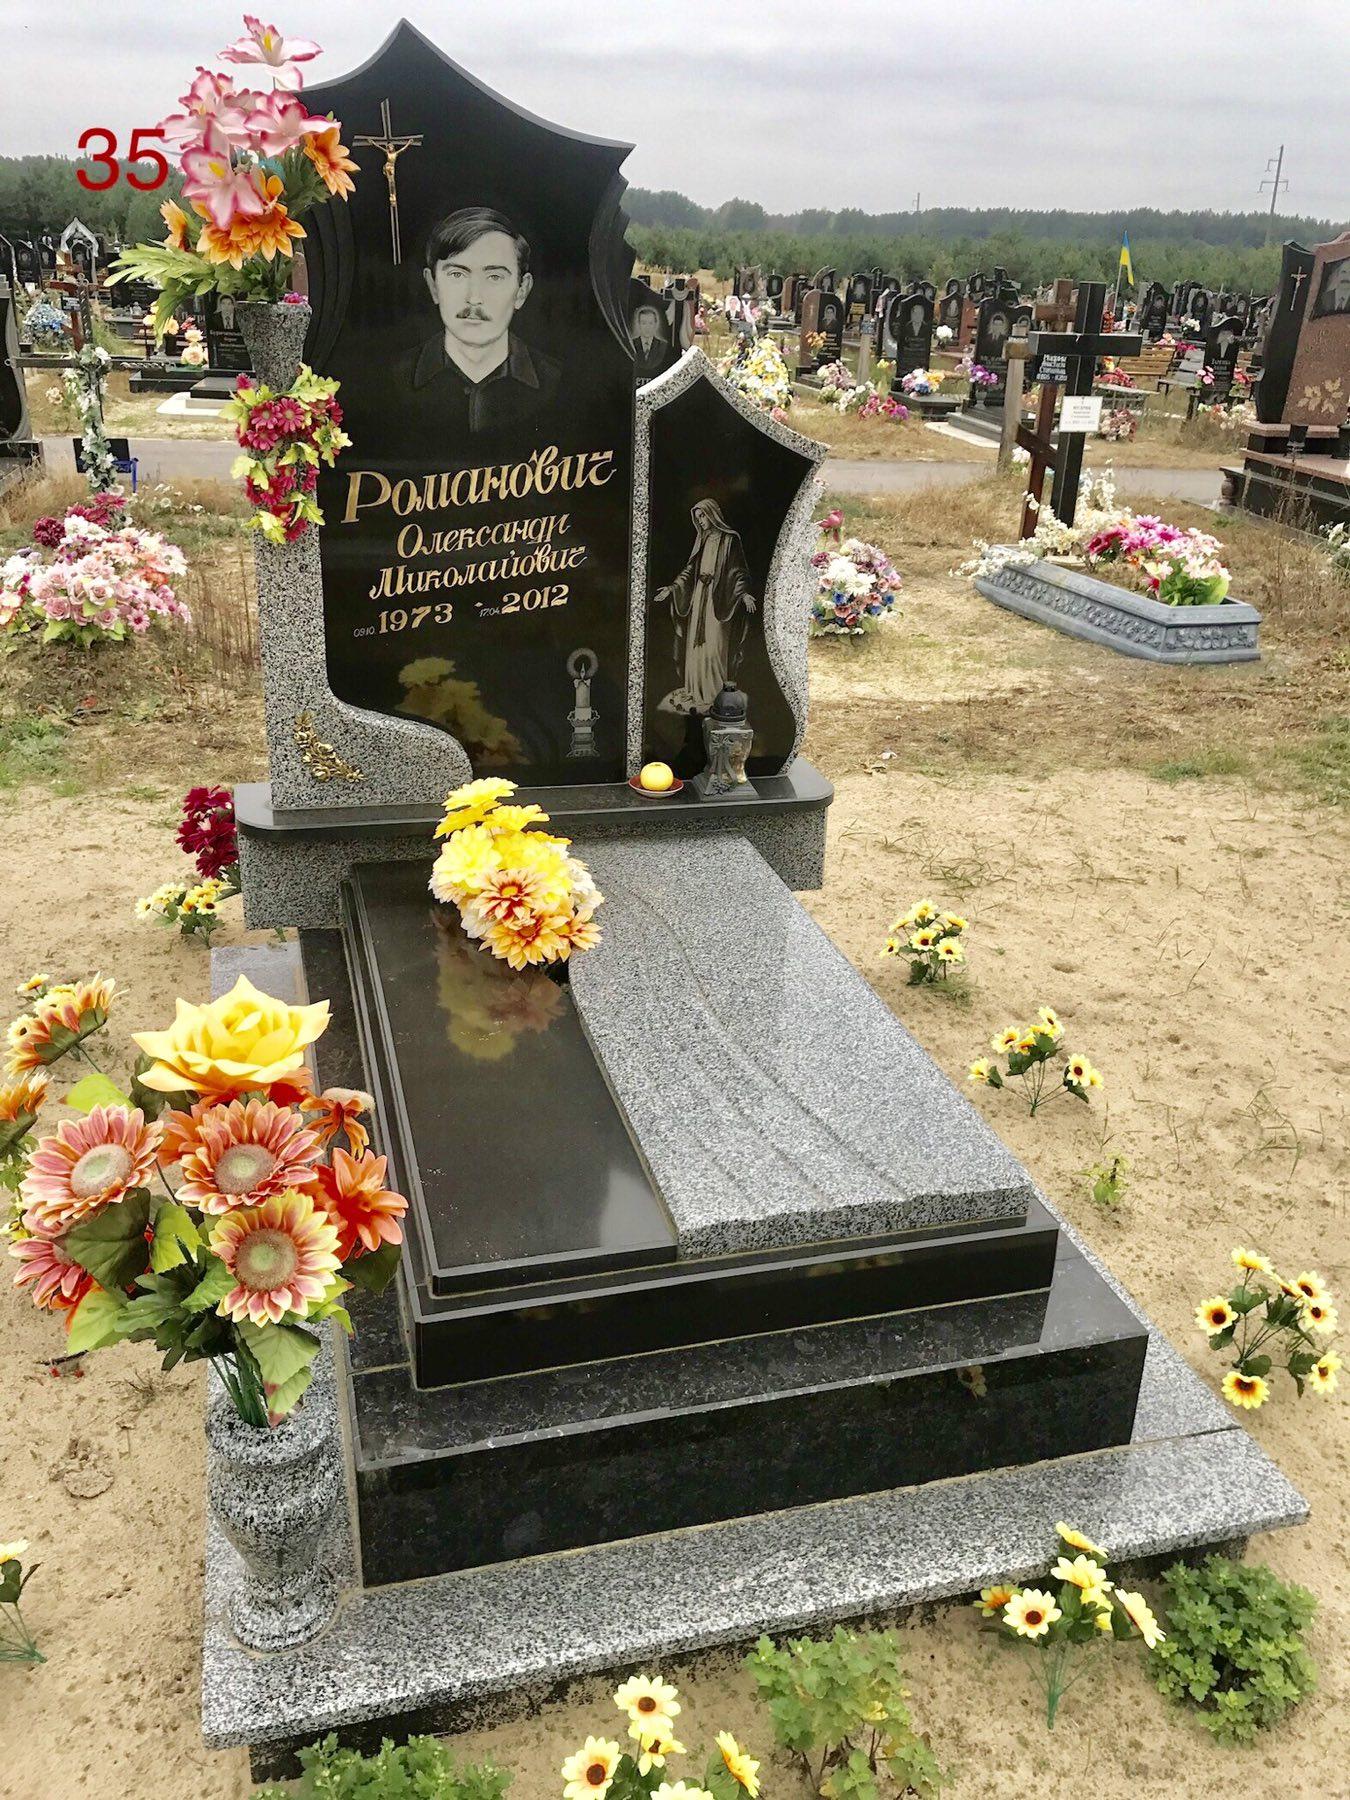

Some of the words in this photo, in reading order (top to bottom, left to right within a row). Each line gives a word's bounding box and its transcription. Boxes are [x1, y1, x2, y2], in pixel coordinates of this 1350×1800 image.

[340, 445, 617, 524] Романович
[368, 543, 588, 600] Миколайович
[378, 602, 453, 634] 1973
[501, 583, 570, 615] 2012
